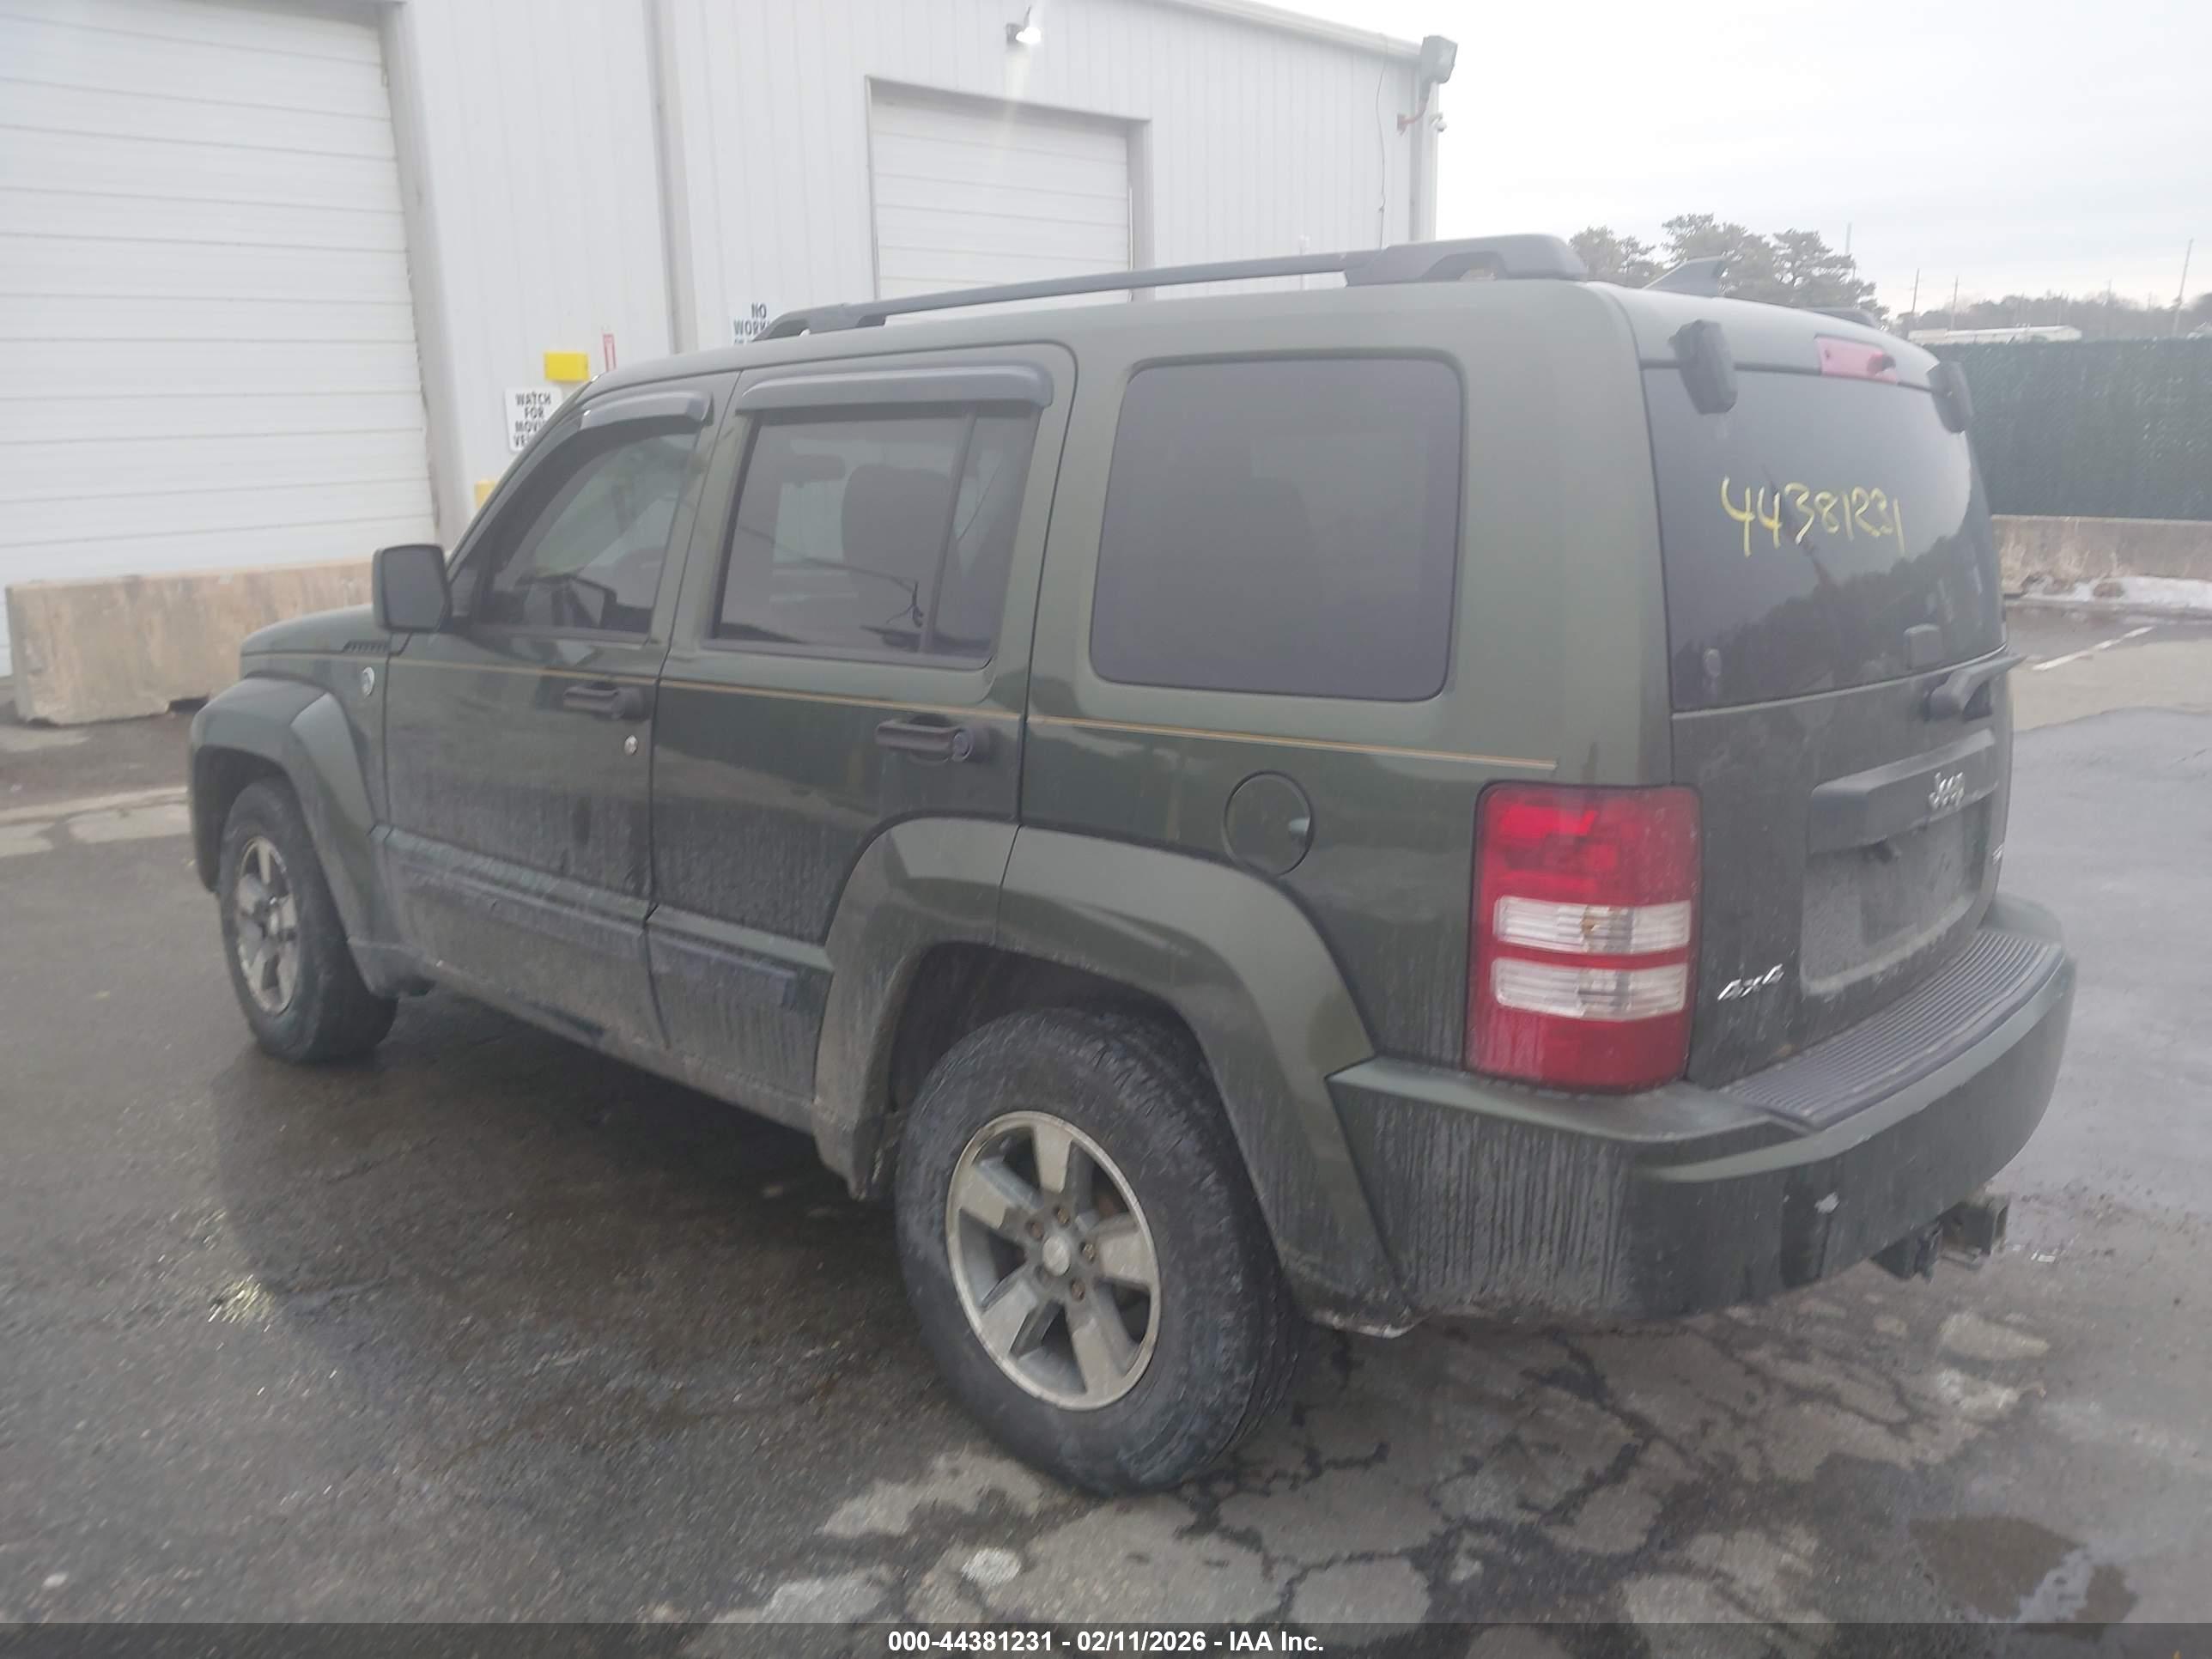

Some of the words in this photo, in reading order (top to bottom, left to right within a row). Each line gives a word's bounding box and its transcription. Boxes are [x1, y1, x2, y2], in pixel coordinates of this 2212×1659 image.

[751, 302, 767, 319] NO
[733, 319, 769, 336] WORK
[515, 391, 551, 405] WATCH
[525, 405, 544, 419] FOR
[515, 420, 544, 433] MOVI
[1720, 474, 1905, 558] 44381231
